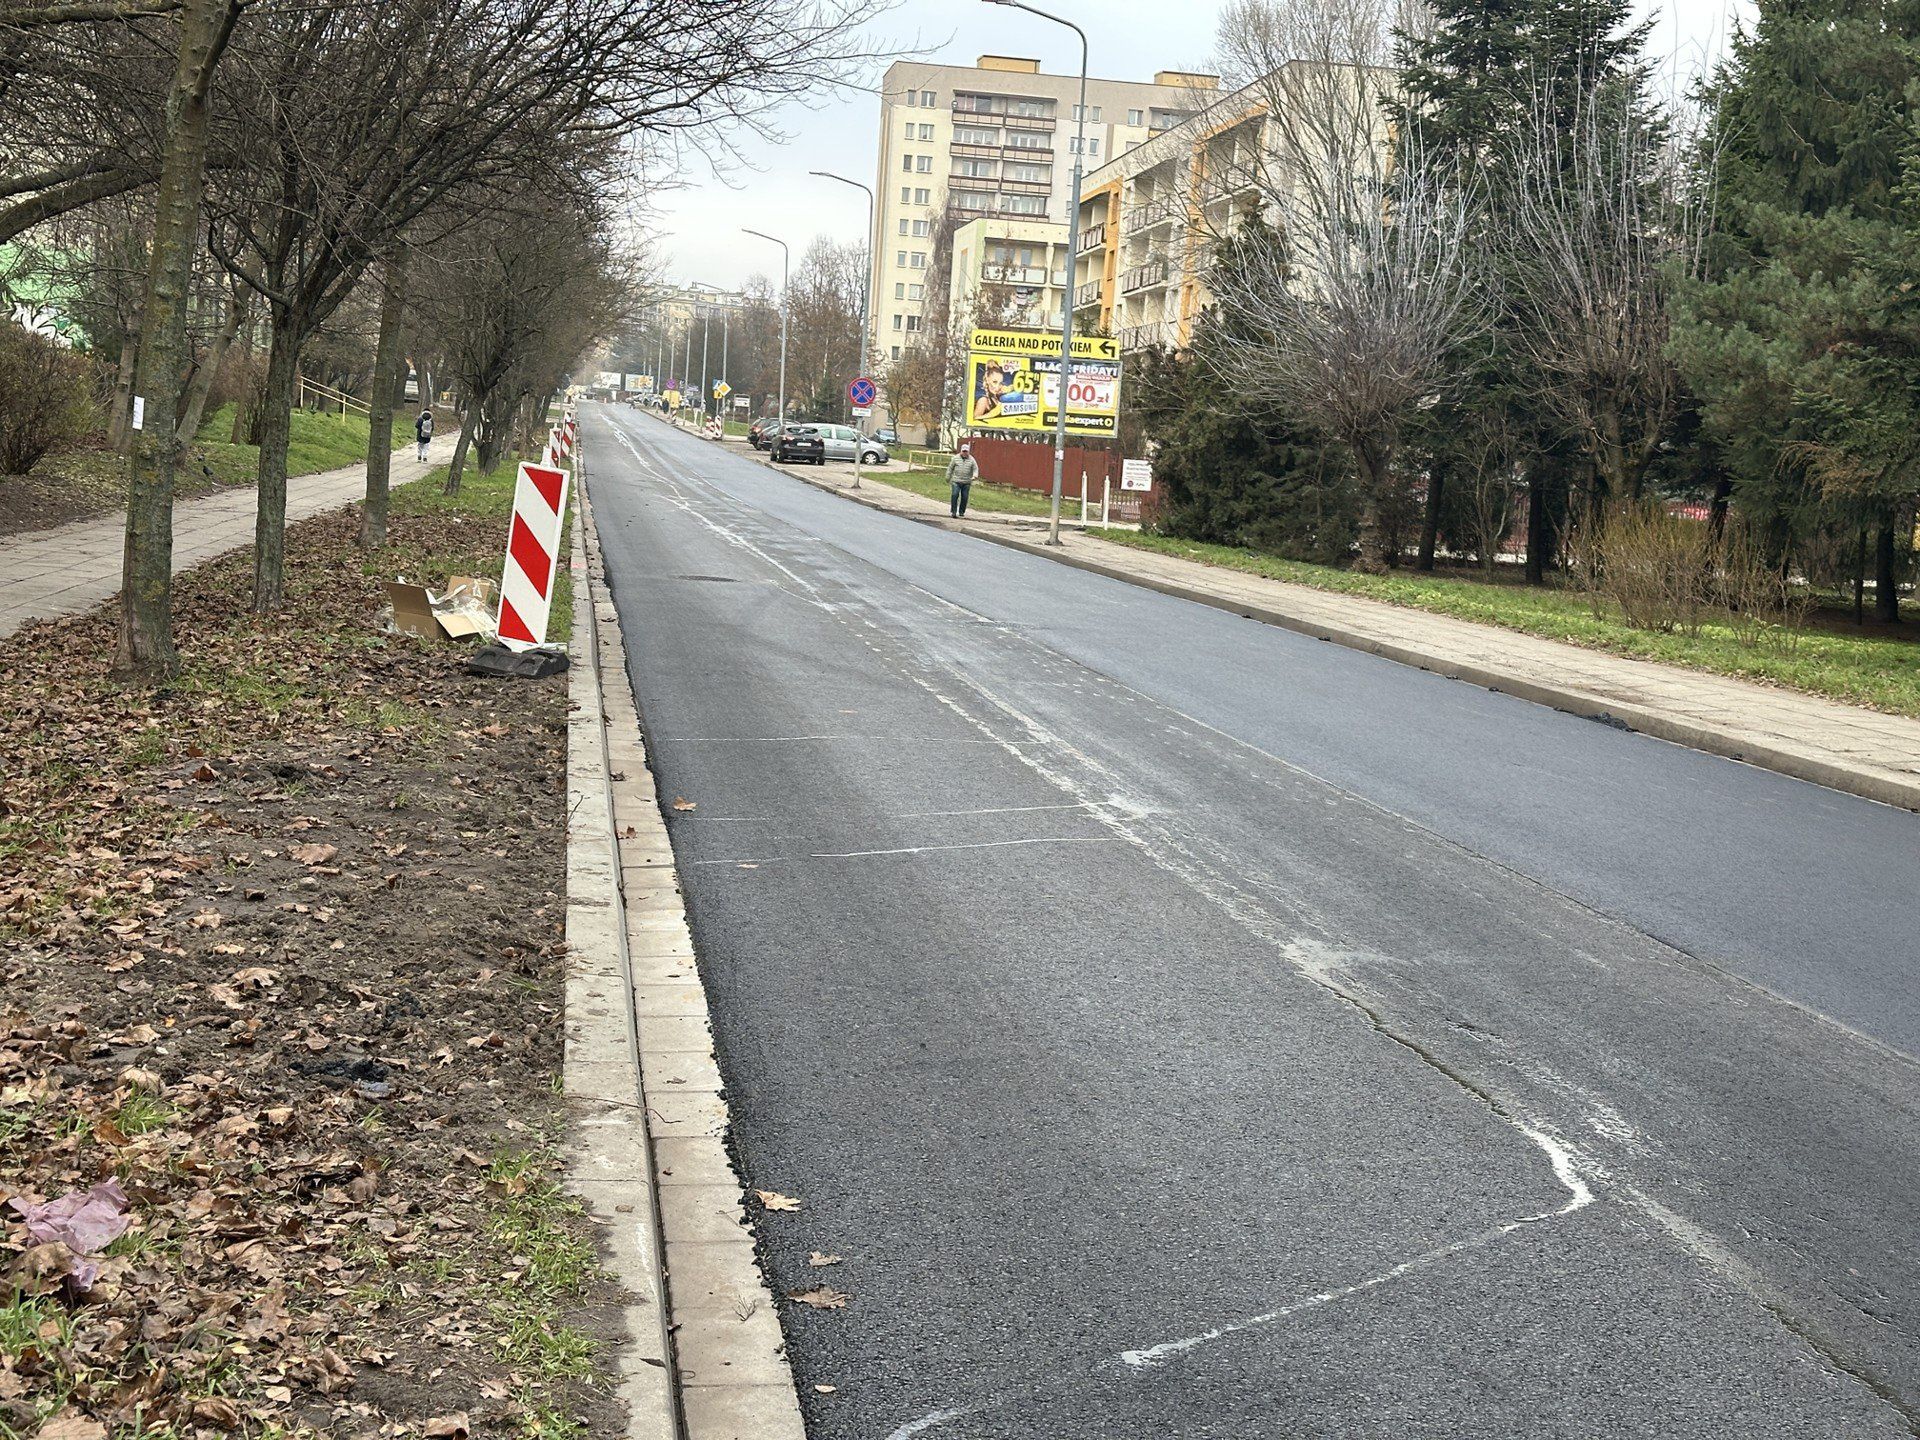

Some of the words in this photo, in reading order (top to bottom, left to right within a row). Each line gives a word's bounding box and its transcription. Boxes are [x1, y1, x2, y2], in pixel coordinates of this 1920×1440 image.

[975, 335, 1016, 348] GALERIA
[1018, 338, 1039, 350] NAD
[1073, 364, 1118, 377] FRIDAY!
[1003, 403, 1037, 413] SAMSUNG
